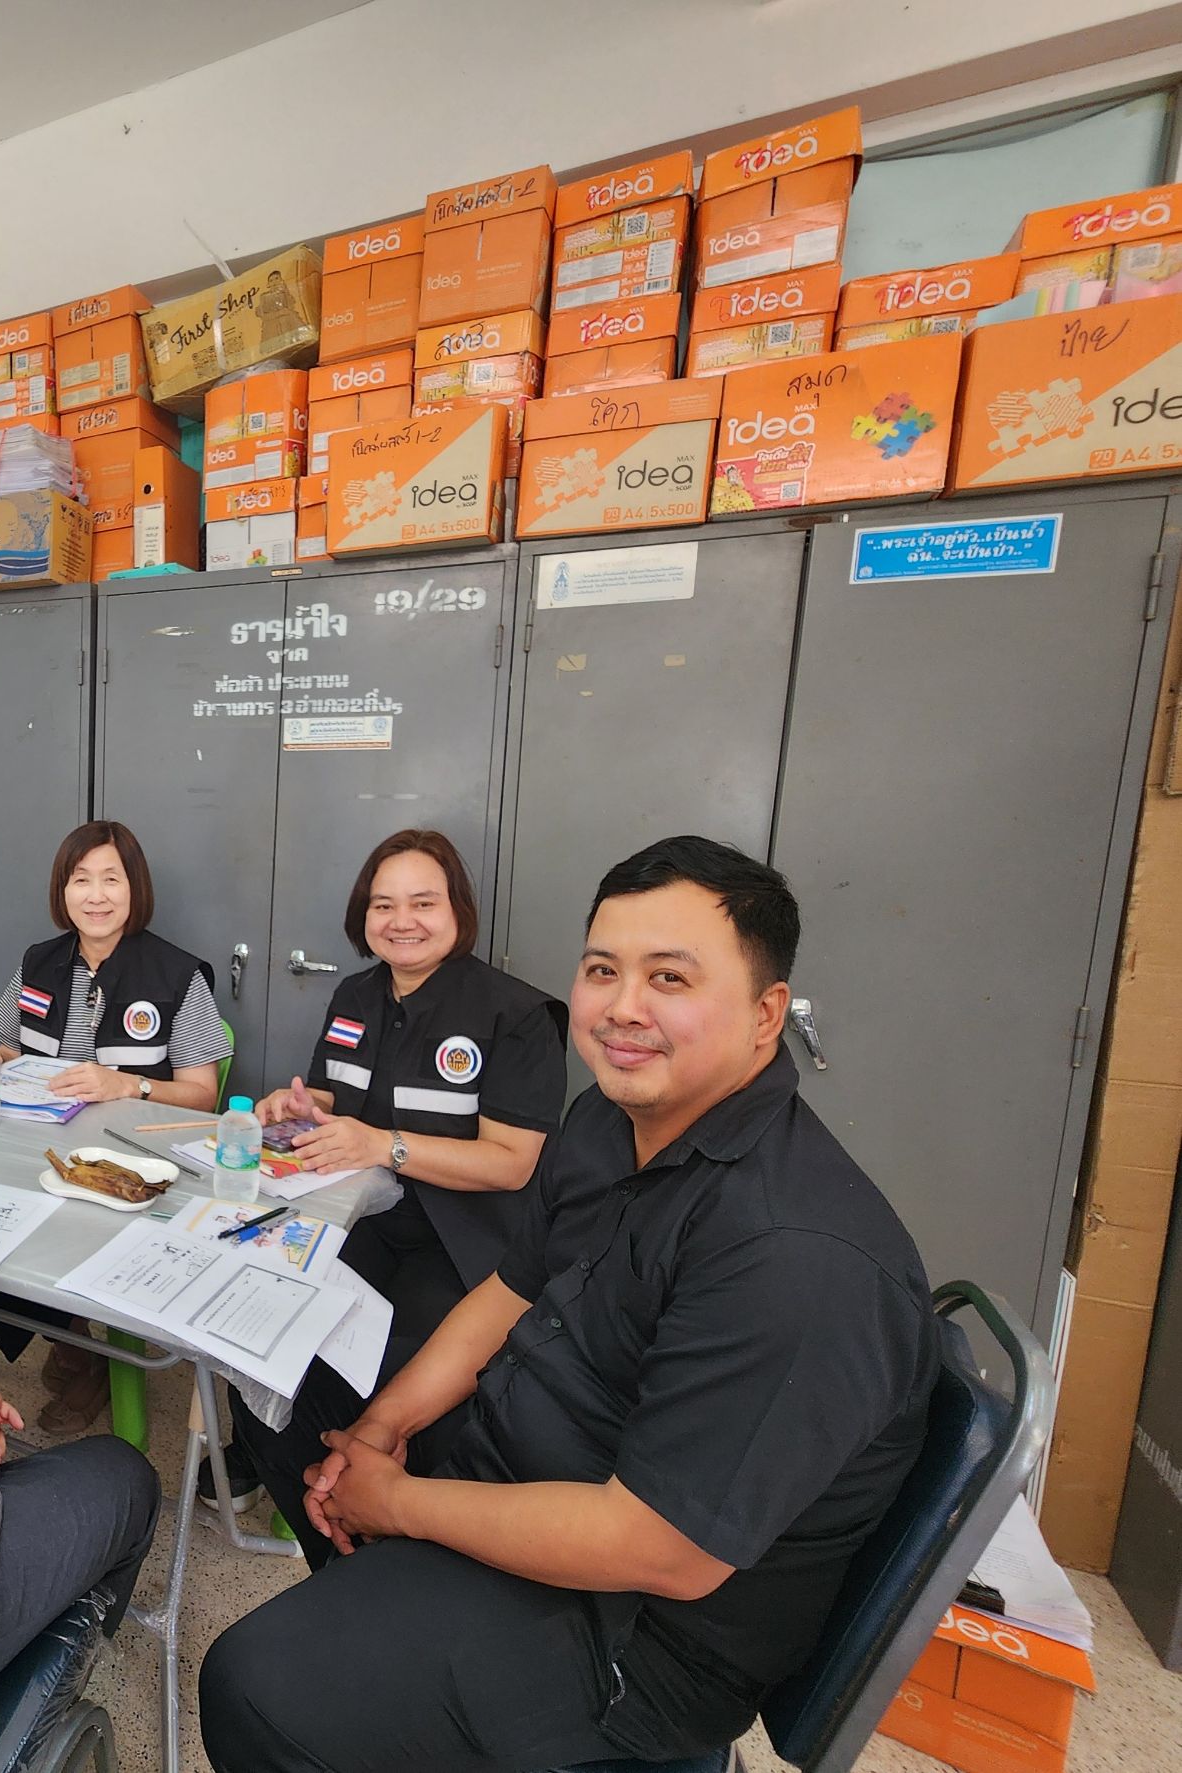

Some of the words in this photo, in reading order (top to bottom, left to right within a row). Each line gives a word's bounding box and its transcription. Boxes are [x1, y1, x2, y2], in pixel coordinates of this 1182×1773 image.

[741, 136, 819, 176] idea
[588, 175, 654, 209] idea
[1073, 203, 1171, 240] idea
[348, 234, 401, 260] idea
[709, 231, 761, 256] idea
[427, 274, 462, 290] idea
[786, 279, 805, 288] MAX
[952, 268, 975, 278] MAX
[730, 287, 804, 318] idea
[885, 276, 972, 312] idea
[170, 312, 215, 354] First
[217, 287, 260, 320] Shop
[580, 313, 644, 343] idea
[1061, 318, 1130, 357] ป้าย
[332, 366, 386, 392] idea
[786, 364, 847, 407] สมุด
[794, 403, 816, 413] MAX
[1113, 388, 1182, 427] ide
[727, 411, 816, 446] idea
[207, 449, 237, 465] idea
[677, 455, 696, 463] MAX
[1120, 446, 1151, 464] A4
[617, 460, 694, 491] idea
[411, 480, 478, 509] idea
[623, 507, 644, 521] A4
[651, 502, 694, 518] 5x500
[419, 523, 436, 537] A4
[442, 518, 480, 534] 5x500
[230, 602, 348, 645] ธารน้ำใจ
[939, 1607, 1030, 1660] ea
